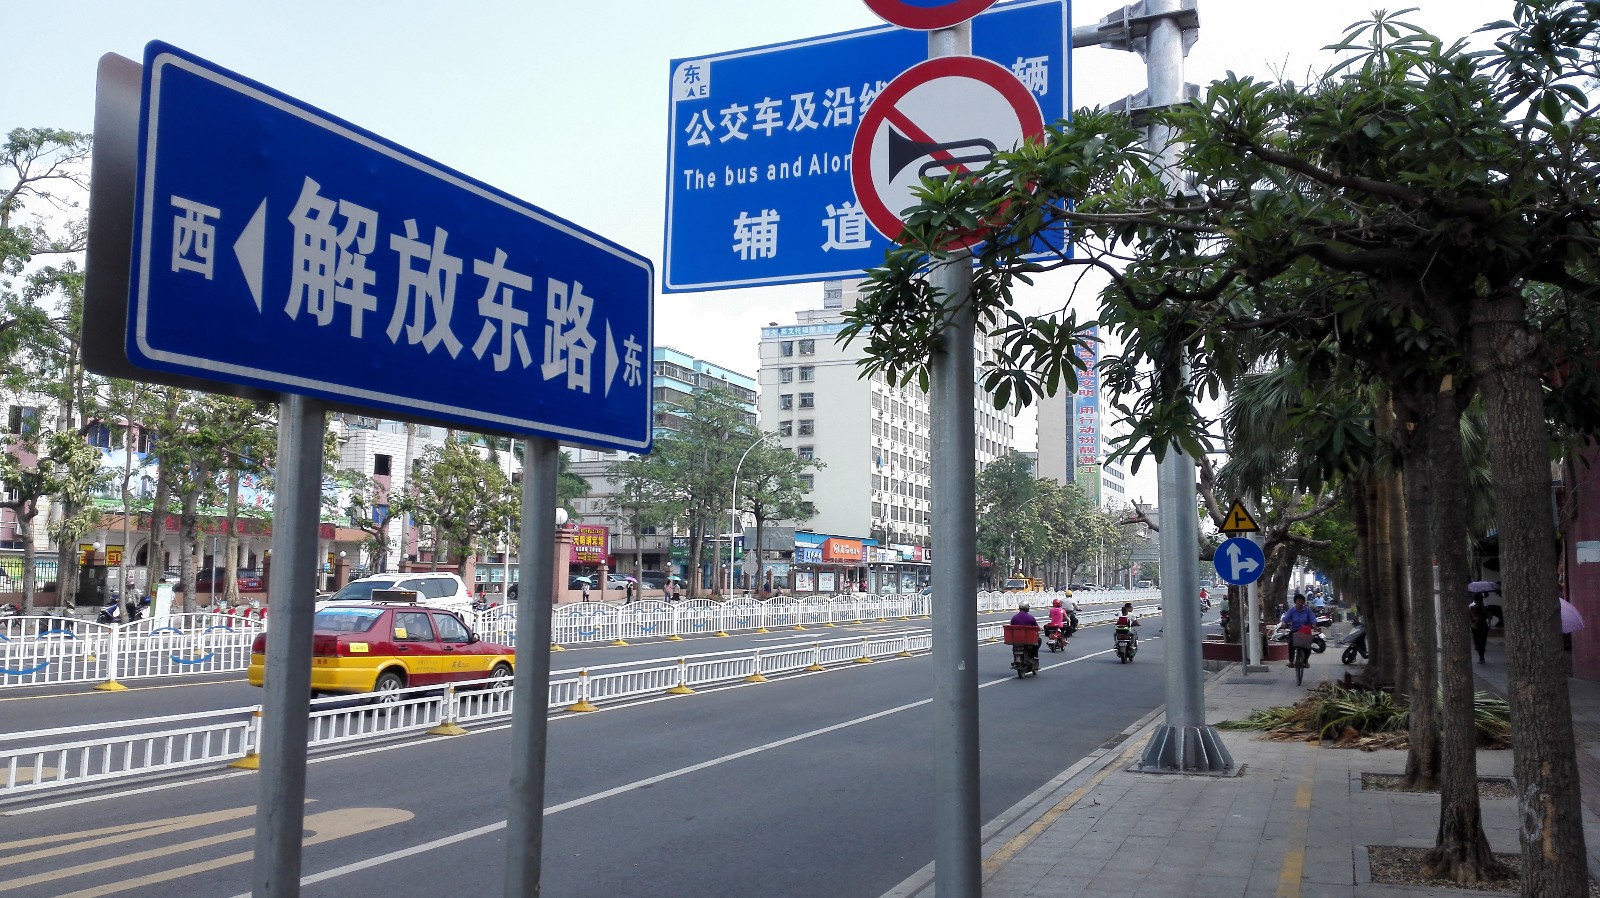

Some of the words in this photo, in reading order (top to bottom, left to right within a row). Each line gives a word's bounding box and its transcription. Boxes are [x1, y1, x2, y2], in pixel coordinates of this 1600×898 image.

[683, 65, 701, 84] 东
[700, 85, 707, 95] E
[684, 168, 716, 190] The
[725, 165, 758, 186] bus
[767, 155, 802, 180] and
[808, 152, 852, 176] Alon
[170, 194, 221, 281] 西
[284, 175, 597, 394] 解放东路
[623, 333, 643, 387] 东
